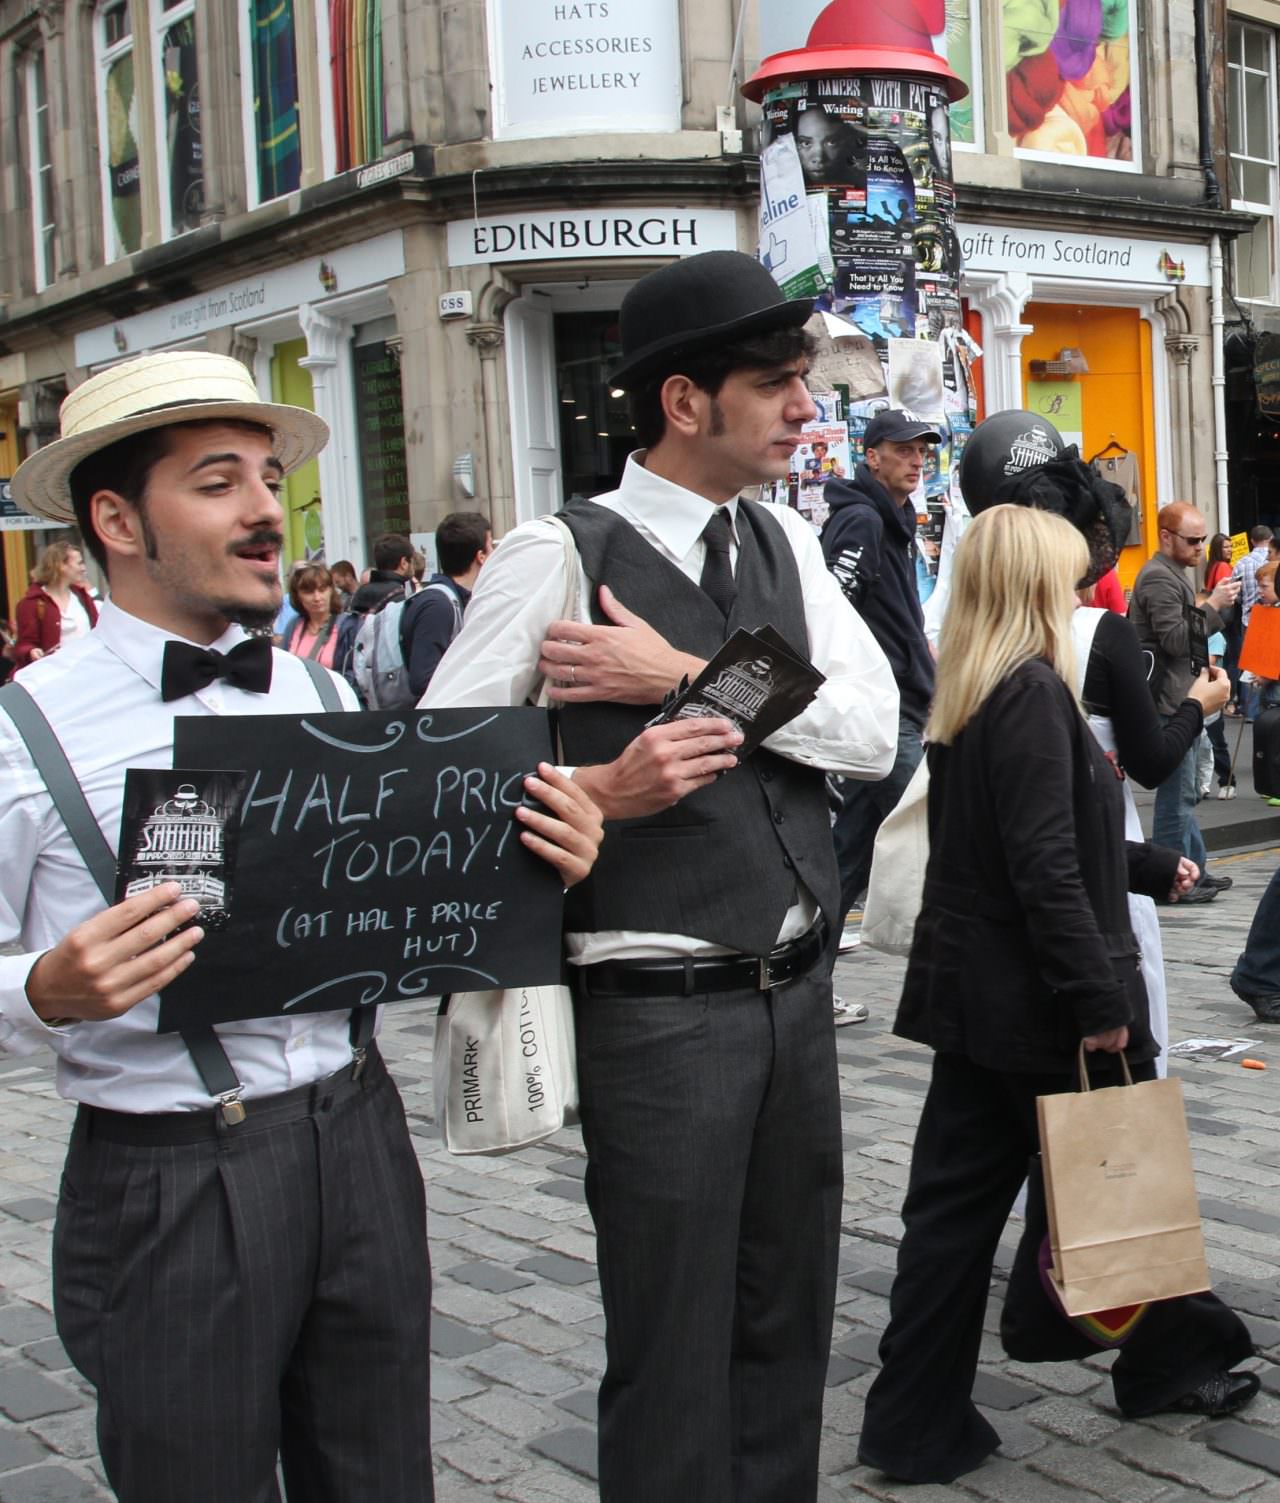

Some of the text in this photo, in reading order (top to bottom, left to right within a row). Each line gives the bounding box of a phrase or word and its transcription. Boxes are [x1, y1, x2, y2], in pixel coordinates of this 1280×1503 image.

[554, 3, 609, 20] HATS
[522, 37, 653, 60] ACCESSORIES
[532, 72, 641, 95] JEWELLERY
[870, 79, 902, 108] WITH
[822, 102, 864, 118] Waiting
[877, 155, 889, 164] All
[474, 218, 699, 255] EDINBURGH
[962, 232, 1133, 267] gift from Scotland
[848, 273, 867, 283] That
[877, 274, 889, 283] All
[889, 275, 904, 284] You
[848, 282, 905, 292] Need to Know
[229, 281, 265, 313] Scotland
[241, 768, 409, 834] HALF
[313, 819, 512, 889] TODAY!
[276, 907, 332, 948] (AT
[432, 901, 503, 923] PRICE
[404, 928, 479, 959] HUT)
[463, 1035, 485, 1123] PRIMARK
[525, 1064, 546, 1112] 100%
